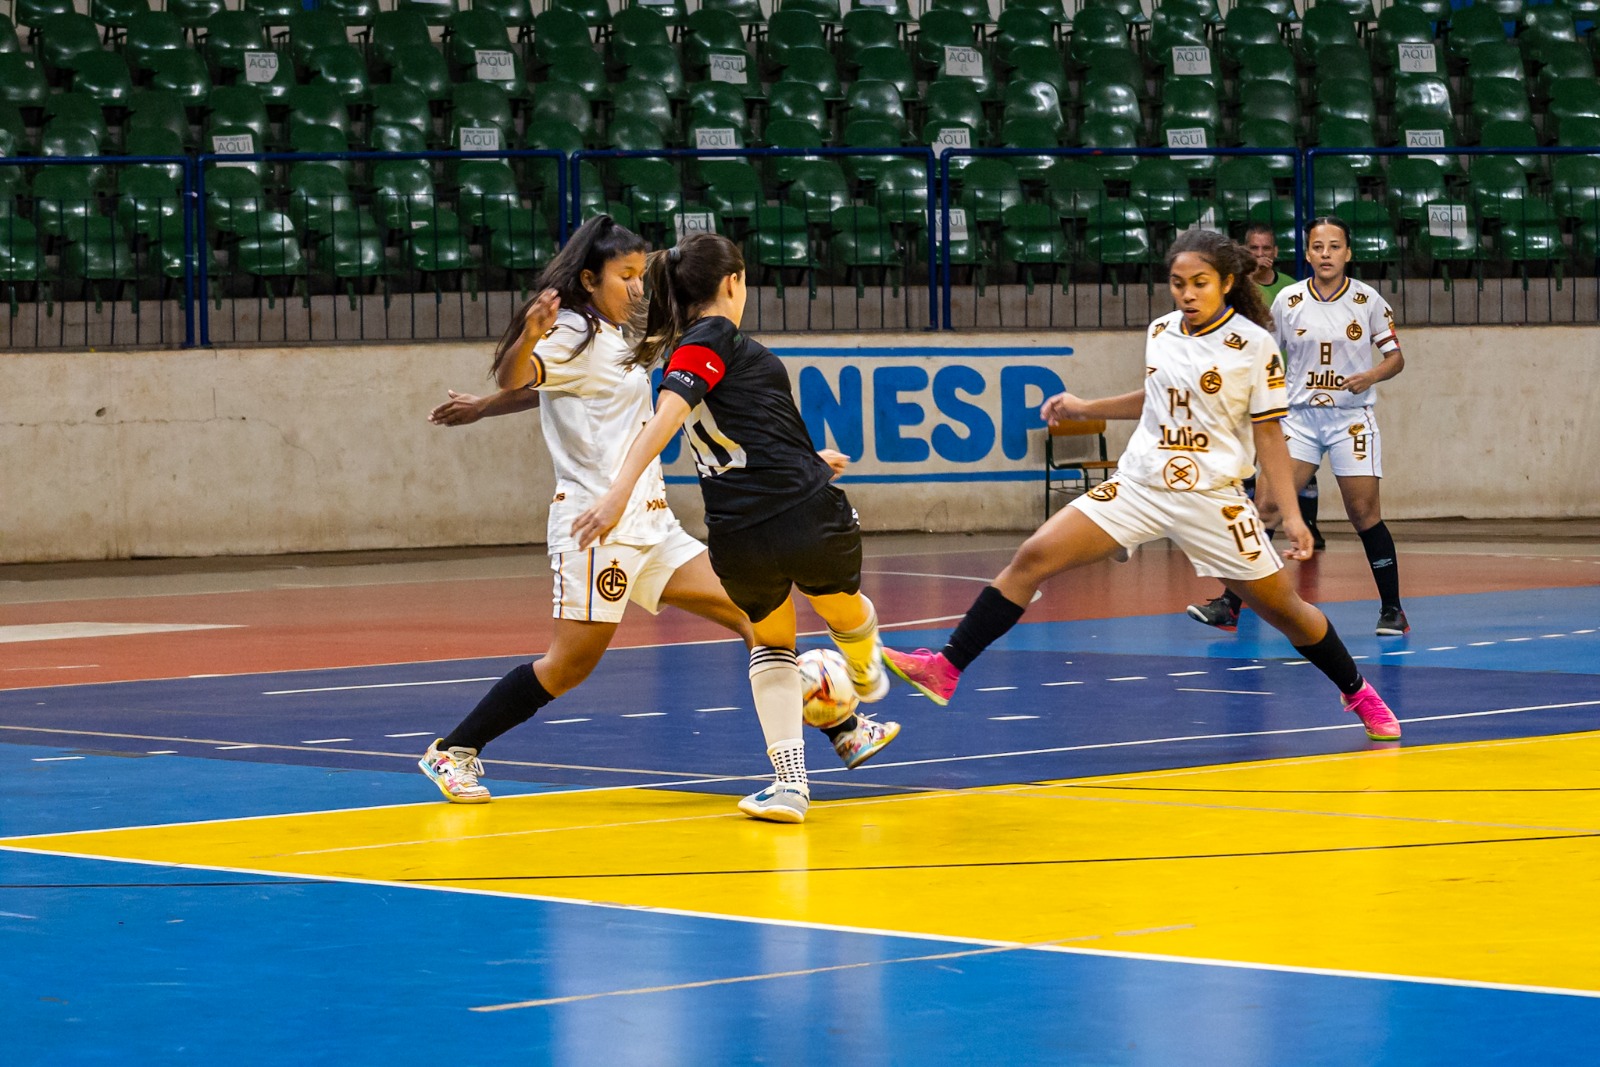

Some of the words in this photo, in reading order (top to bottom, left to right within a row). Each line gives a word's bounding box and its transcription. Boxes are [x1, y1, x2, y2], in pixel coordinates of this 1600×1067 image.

[948, 52, 979, 63] AQUI
[1176, 51, 1207, 62] AQUI
[1402, 49, 1433, 60] AQUI
[480, 56, 511, 66] AQUI
[713, 59, 742, 70] AQUI
[464, 134, 496, 146] AQUI
[699, 134, 732, 146] AQUI
[937, 134, 967, 145] AQUI
[1172, 134, 1203, 146] AQUI
[1410, 136, 1441, 146] AQUI
[218, 141, 250, 153] AQUI
[1431, 211, 1464, 223] AQUI
[1320, 342, 1332, 365] 8
[1306, 370, 1345, 387] Julio
[1167, 388, 1192, 420] 14
[682, 398, 747, 477] 0
[1159, 424, 1209, 448] Julio
[1353, 434, 1366, 452] 8
[1227, 517, 1261, 552] 14
